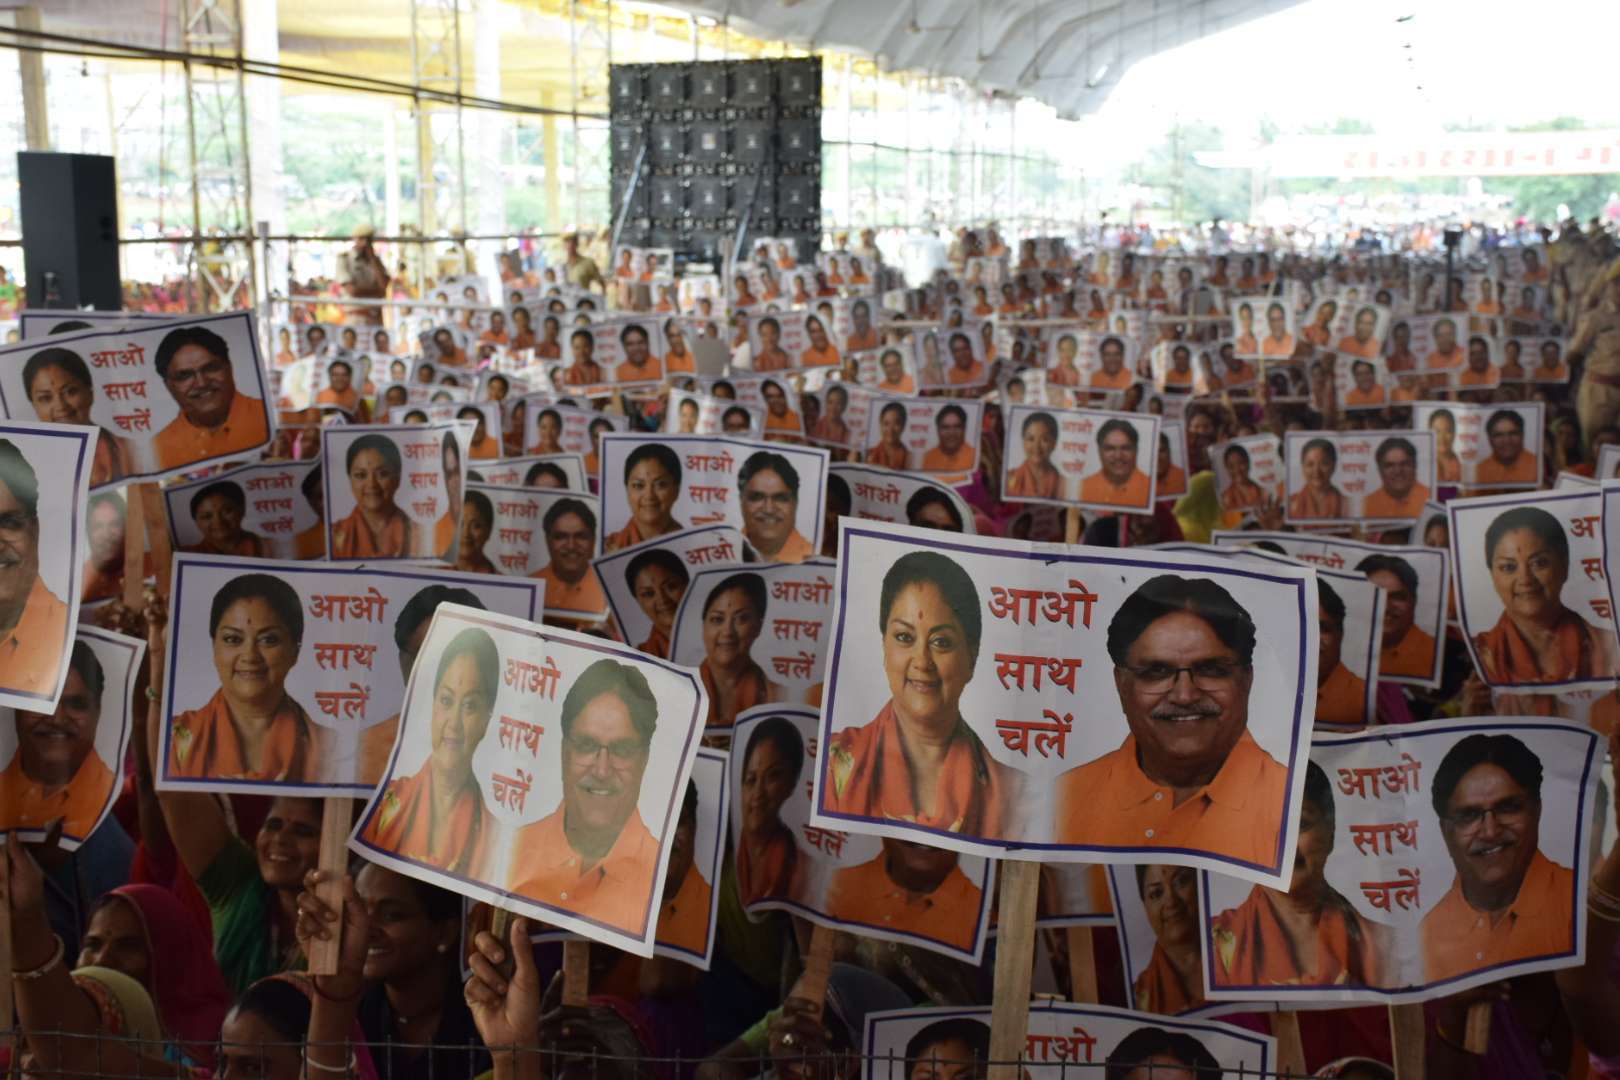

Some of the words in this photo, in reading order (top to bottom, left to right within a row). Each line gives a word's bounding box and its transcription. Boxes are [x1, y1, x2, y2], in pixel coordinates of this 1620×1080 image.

[90, 343, 146, 368] आओ
[103, 380, 147, 399] साथ
[114, 409, 151, 432] चलें
[686, 449, 737, 472] आओ
[246, 472, 297, 491] आओ
[688, 483, 732, 503] साथ
[854, 482, 903, 504] आओ
[254, 497, 296, 512] साथ
[498, 500, 541, 518] आओ
[260, 517, 296, 534] चलें
[498, 527, 533, 545] साथ
[500, 553, 530, 569] चलें
[686, 539, 738, 565] आओ
[772, 575, 834, 605] आओ
[987, 578, 1101, 628] आओ
[309, 586, 389, 622] आओ
[772, 617, 824, 642] साथ
[312, 642, 377, 670] साथ
[771, 650, 817, 678] चलें
[504, 655, 564, 702] आओ
[993, 652, 1085, 693] साथ
[314, 683, 372, 720] चलें
[497, 714, 546, 756] साथ
[993, 708, 1075, 756] चलें
[1336, 751, 1421, 798] आओ
[490, 768, 534, 817] चलें
[1348, 820, 1419, 855] साथ
[1356, 868, 1422, 913] चलें
